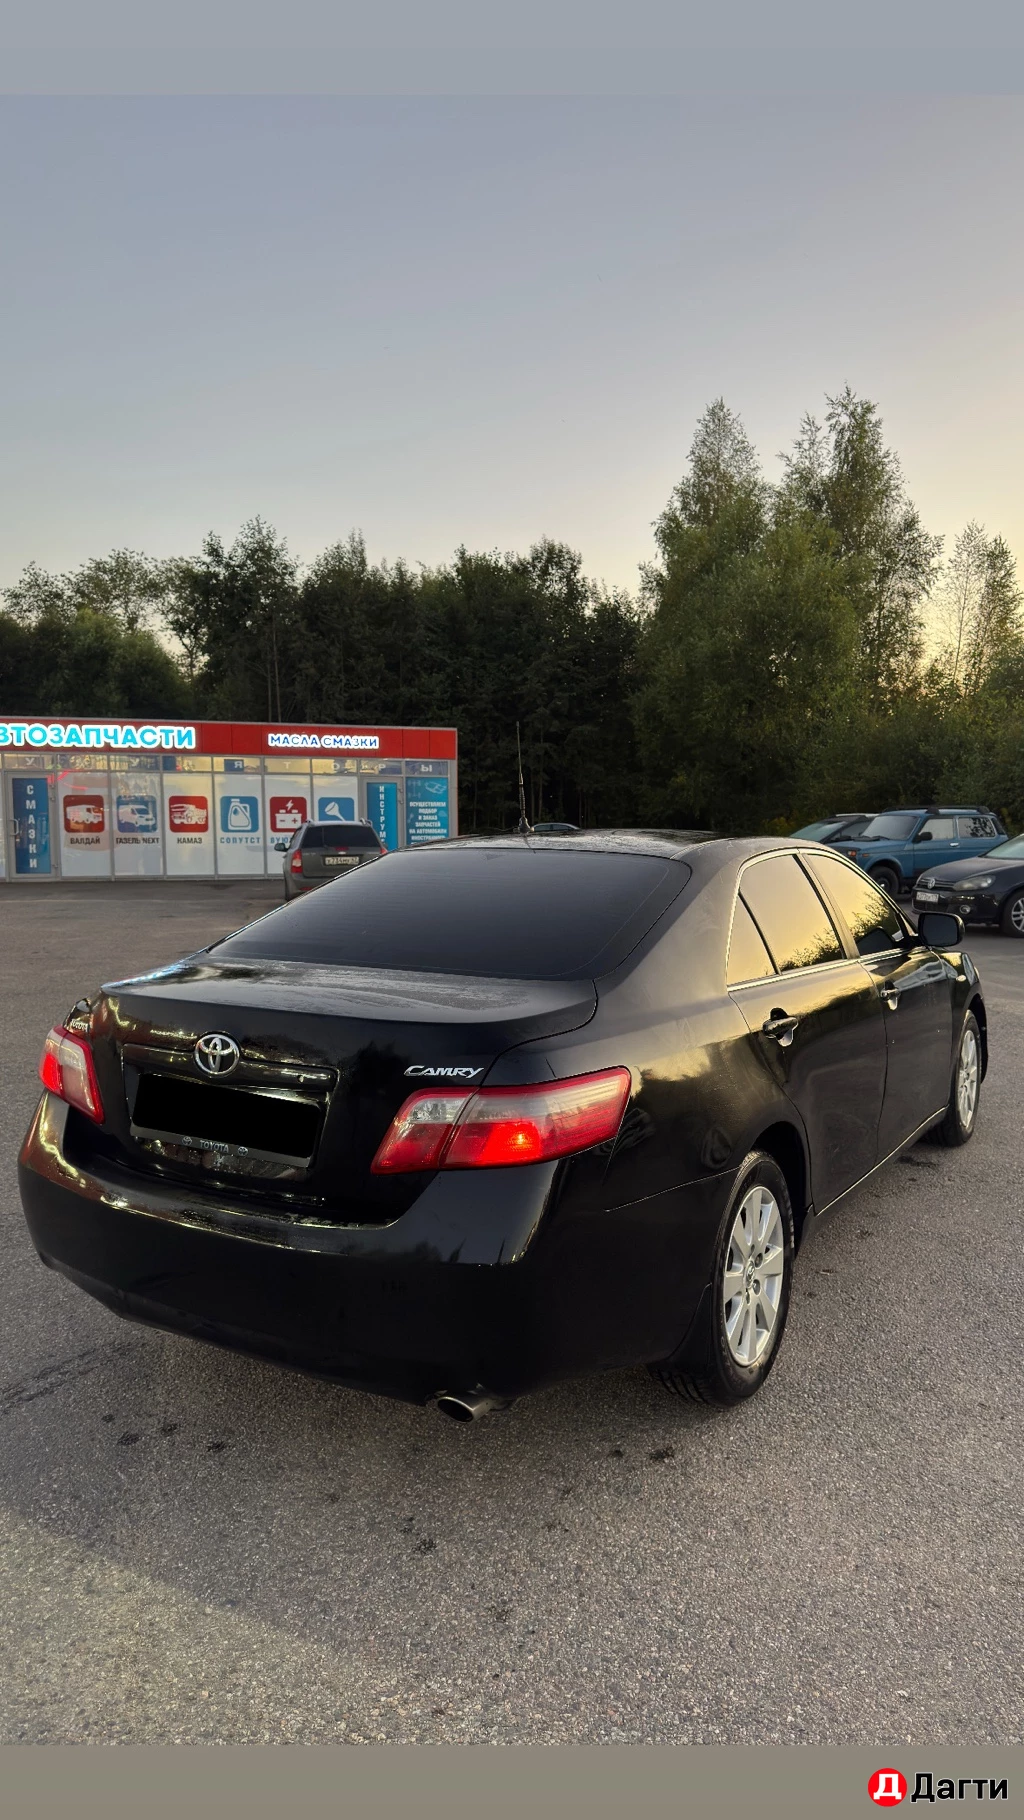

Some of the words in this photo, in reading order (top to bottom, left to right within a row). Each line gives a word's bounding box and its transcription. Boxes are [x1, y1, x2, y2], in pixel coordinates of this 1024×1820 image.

[269, 734, 319, 747] МАСЛА
[322, 735, 378, 748] СМАЗКИ
[25, 784, 37, 868] СМАЗКИ
[70, 837, 100, 845] ВАЛДАЙ
[116, 837, 140, 845] ГАЗЕЛЬ
[404, 1065, 484, 1078] CAMRY
[199, 1140, 229, 1153] TOYOTA
